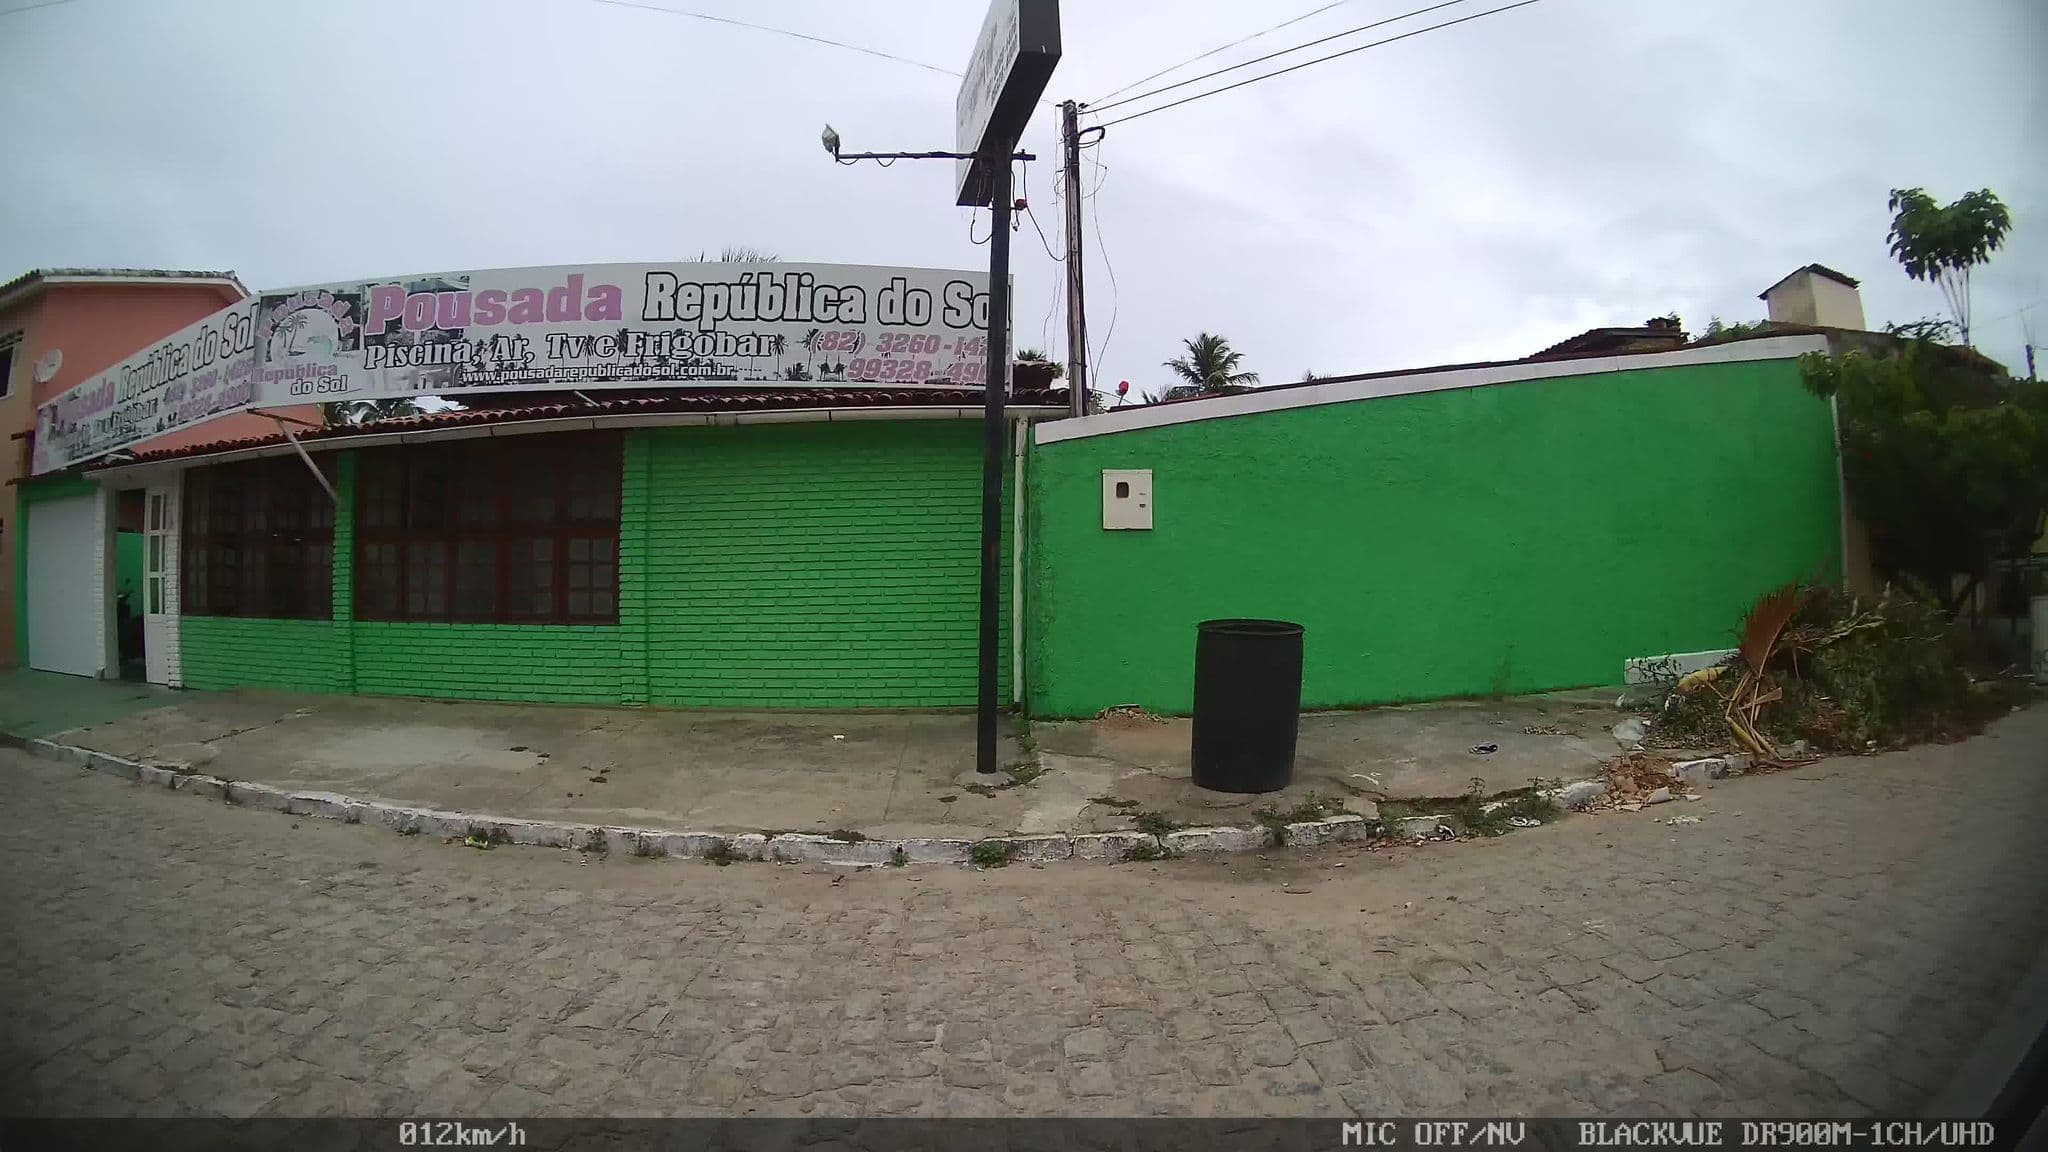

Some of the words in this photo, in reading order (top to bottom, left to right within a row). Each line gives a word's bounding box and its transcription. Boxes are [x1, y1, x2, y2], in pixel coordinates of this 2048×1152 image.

[365, 273, 623, 335] Pousada
[642, 272, 866, 331] República
[877, 277, 932, 327] do
[943, 281, 1011, 330] So
[193, 324, 218, 372] do
[221, 302, 259, 350] Sol
[364, 337, 481, 370] Piscina,
[491, 334, 536, 363] Ar,
[547, 333, 588, 360] Tv
[594, 335, 616, 358] e
[624, 331, 776, 360] Frigobar
[809, 329, 866, 355] (82)
[291, 378, 313, 395] do
[317, 375, 347, 392] Sol
[462, 363, 734, 382] www.pousadarepublicadosol.com.br
